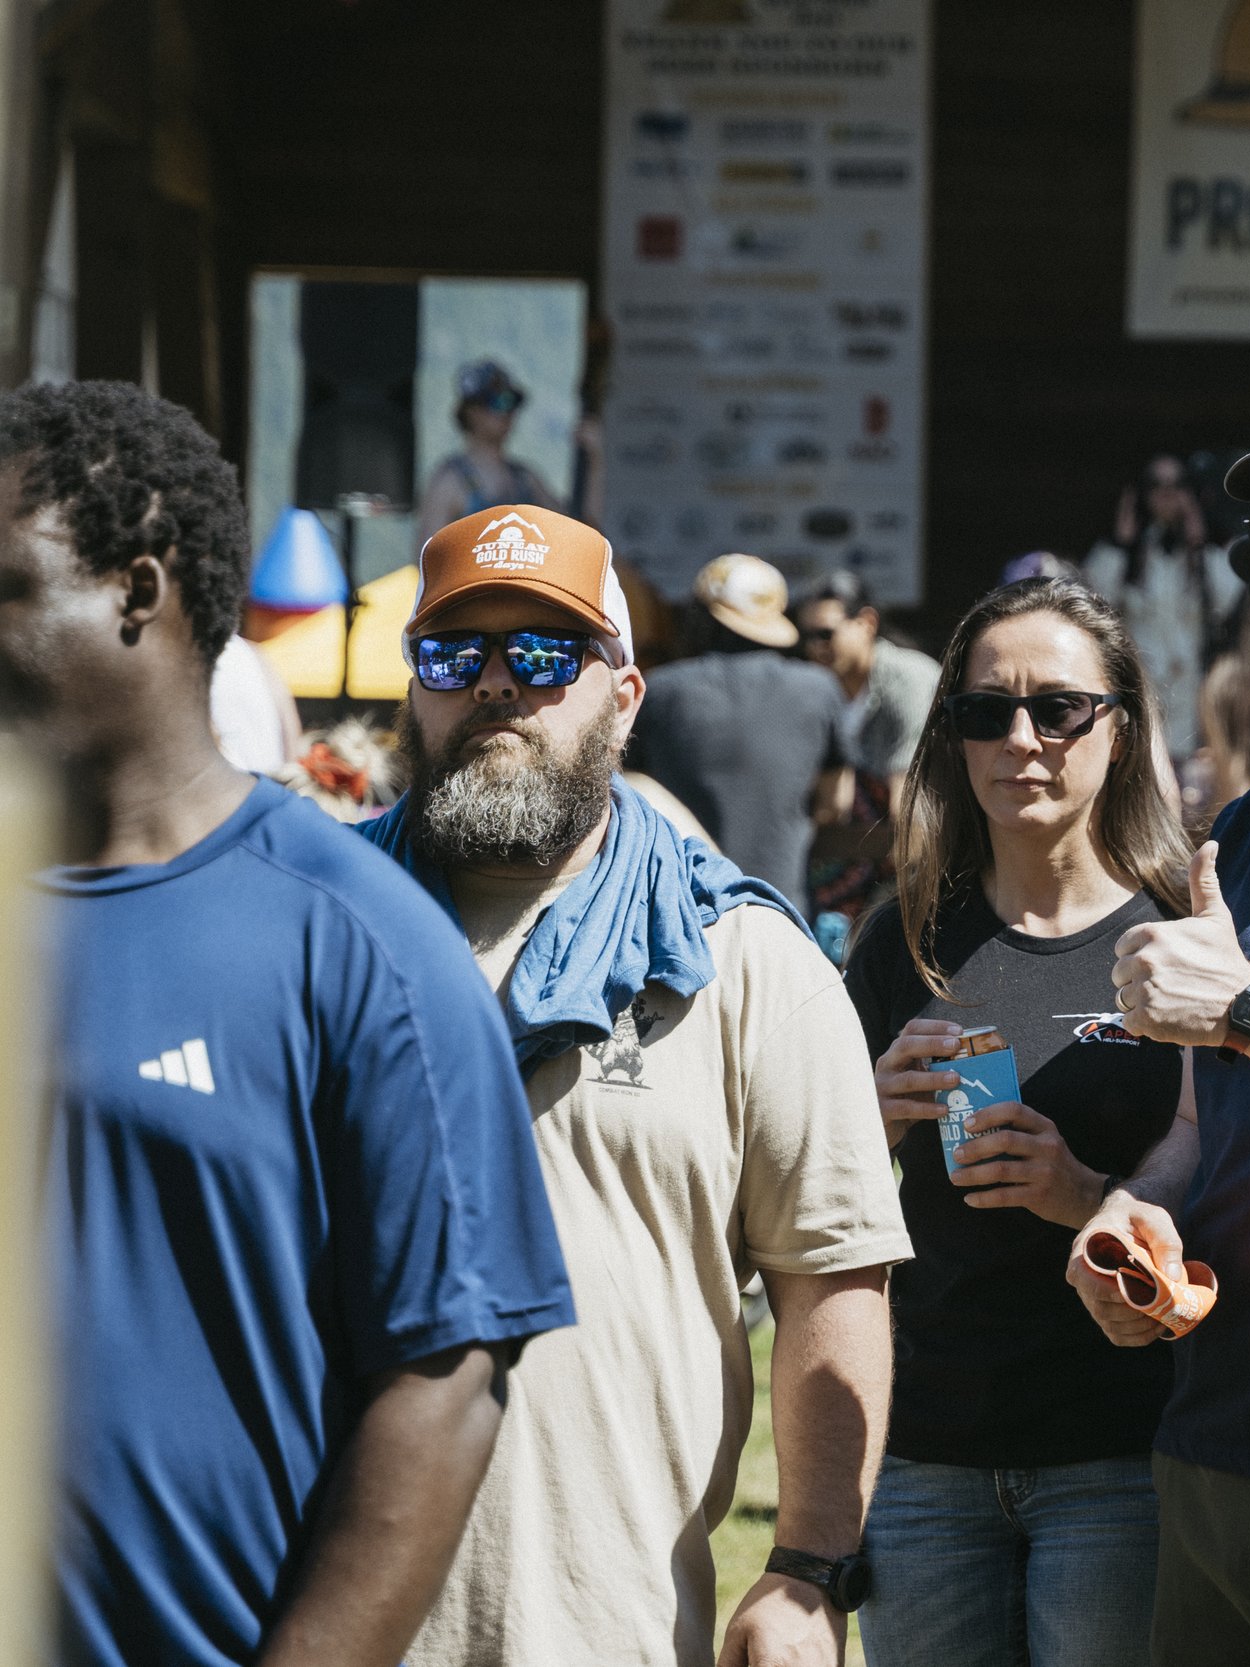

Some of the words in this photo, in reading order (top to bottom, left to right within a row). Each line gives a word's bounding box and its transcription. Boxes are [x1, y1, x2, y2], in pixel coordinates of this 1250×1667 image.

[472, 542, 550, 553] JUNEAU
[476, 549, 508, 563] GOLD
[510, 549, 544, 565] RUSH
[494, 561, 525, 571] days
[1103, 1038, 1140, 1046] HELI-SUPPORT
